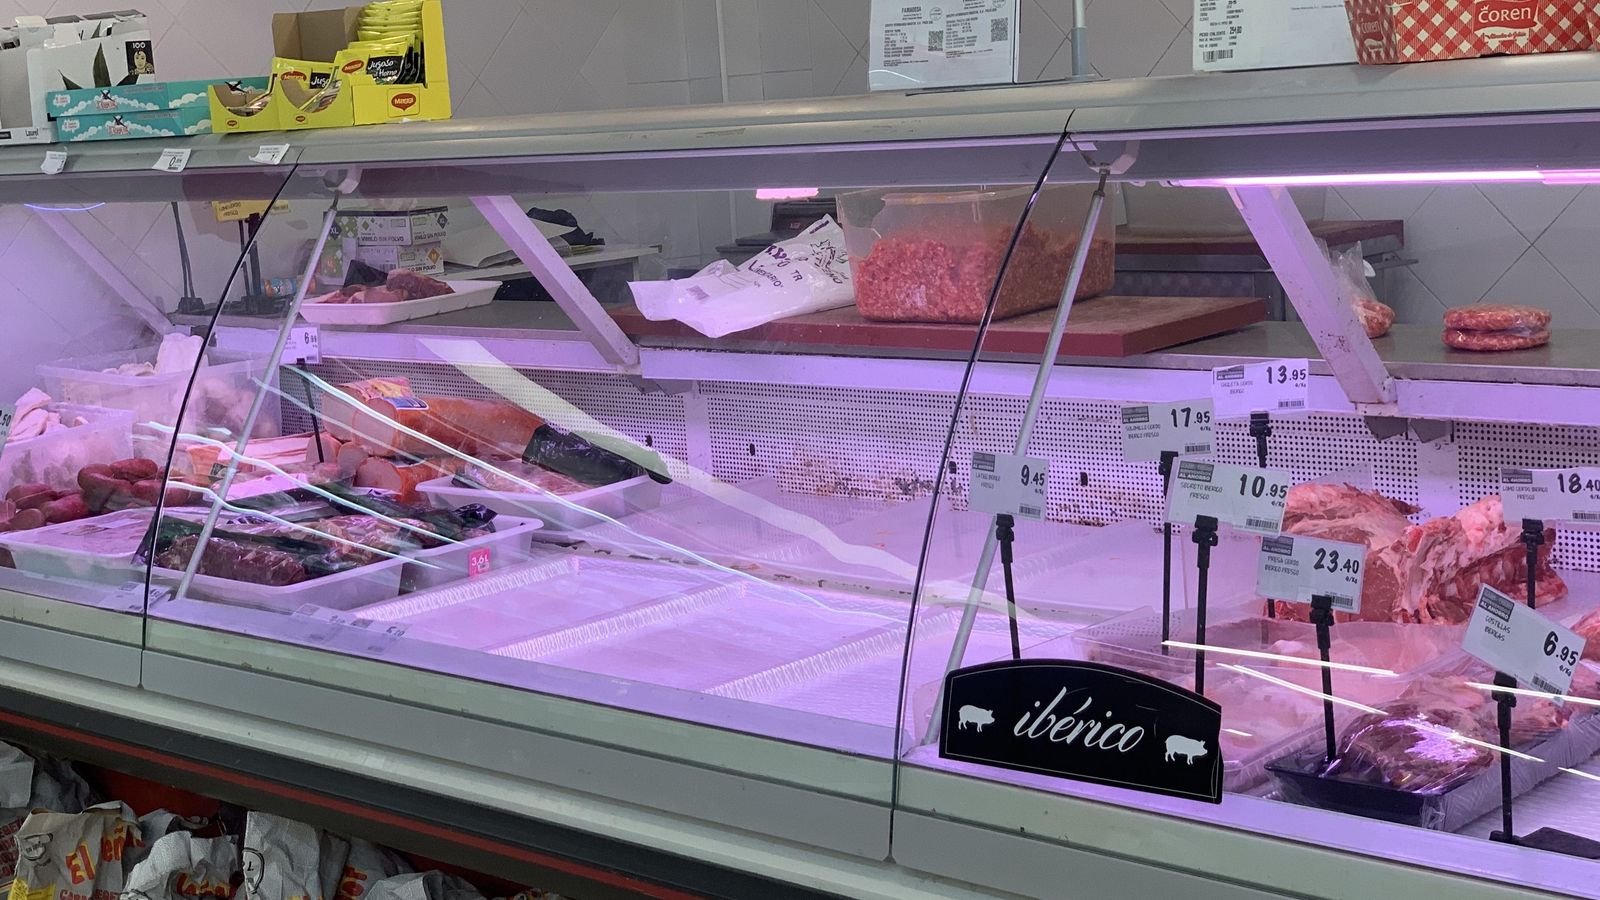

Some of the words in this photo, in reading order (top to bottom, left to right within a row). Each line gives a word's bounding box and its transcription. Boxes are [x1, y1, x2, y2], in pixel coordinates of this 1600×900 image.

[330, 226, 338, 234] XL
[1266, 365, 1306, 384] 13.95
[1170, 406, 1210, 428] 17.95
[1020, 464, 1045, 486] 9.45
[1239, 473, 1288, 499] 10.95
[1558, 472, 1600, 494] 18.40
[1313, 547, 1360, 574] 23.40
[1485, 615, 1511, 634] COSTILLAS
[1543, 631, 1579, 666] 6.95
[1013, 686, 1145, 753] ibérico
